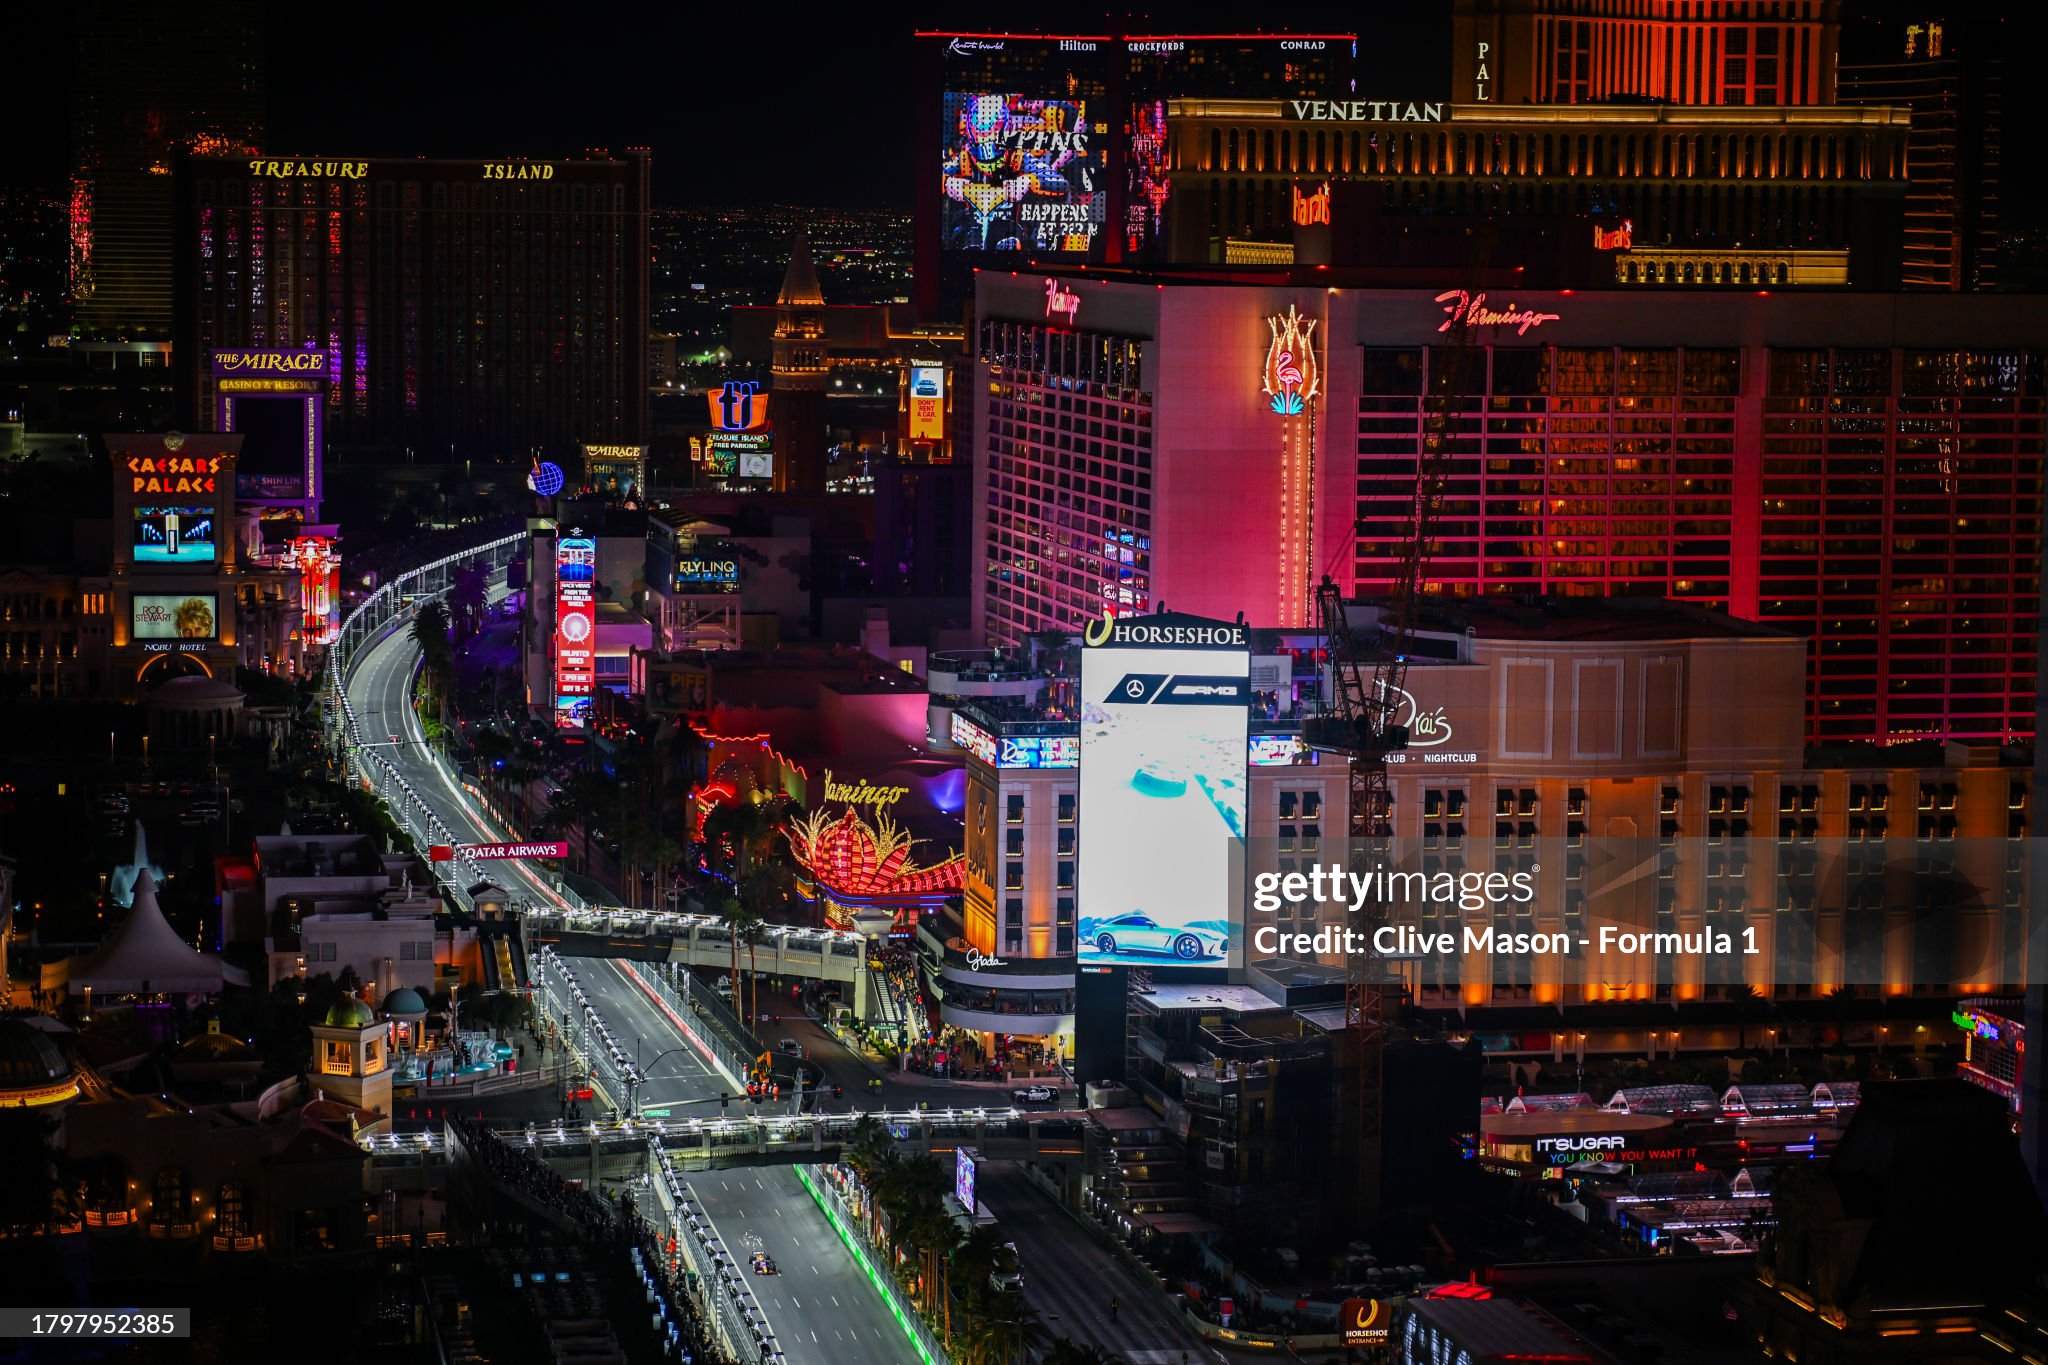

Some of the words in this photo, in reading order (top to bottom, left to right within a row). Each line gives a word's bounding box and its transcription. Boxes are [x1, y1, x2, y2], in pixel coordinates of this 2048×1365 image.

[1059, 40, 1097, 51] Hilton
[1128, 42, 1184, 52] CROCKFORDS
[1280, 40, 1326, 50] CONRAD
[1290, 100, 1443, 122] VENETIAN
[249, 160, 368, 179] TREASURE
[483, 164, 554, 179] ISLAND
[1021, 204, 1088, 220] HAPPENS
[1045, 278, 1080, 325] Flamingo
[1434, 289, 1560, 336] Flamingo
[215, 353, 239, 363] THE
[224, 353, 323, 372] MIRAGE
[219, 380, 261, 390] CASINO
[263, 381, 272, 389] &
[274, 381, 319, 390] RESORT
[589, 446, 640, 457] MIRAGE
[128, 457, 220, 474] CAESARS
[593, 465, 616, 474] SHIN
[134, 477, 215, 493] PALACE
[262, 477, 283, 485] SHIN
[679, 561, 735, 573] FLYLINQ
[143, 606, 164, 616] ROD
[135, 614, 173, 622] STEWART
[1424, 754, 1477, 762] NIGHTCLUB
[466, 847, 505, 858] QATAR
[507, 845, 557, 856] AIRWAYS
[966, 947, 1008, 971] Giada
[1536, 1136, 1625, 1152] IT'SUGAR
[1550, 1153, 1575, 1163] YOU
[1579, 1152, 1616, 1162] KNOW
[1620, 1151, 1645, 1161] YOU
[1649, 1149, 1682, 1159] WANT
[1686, 1148, 1698, 1158] IT
